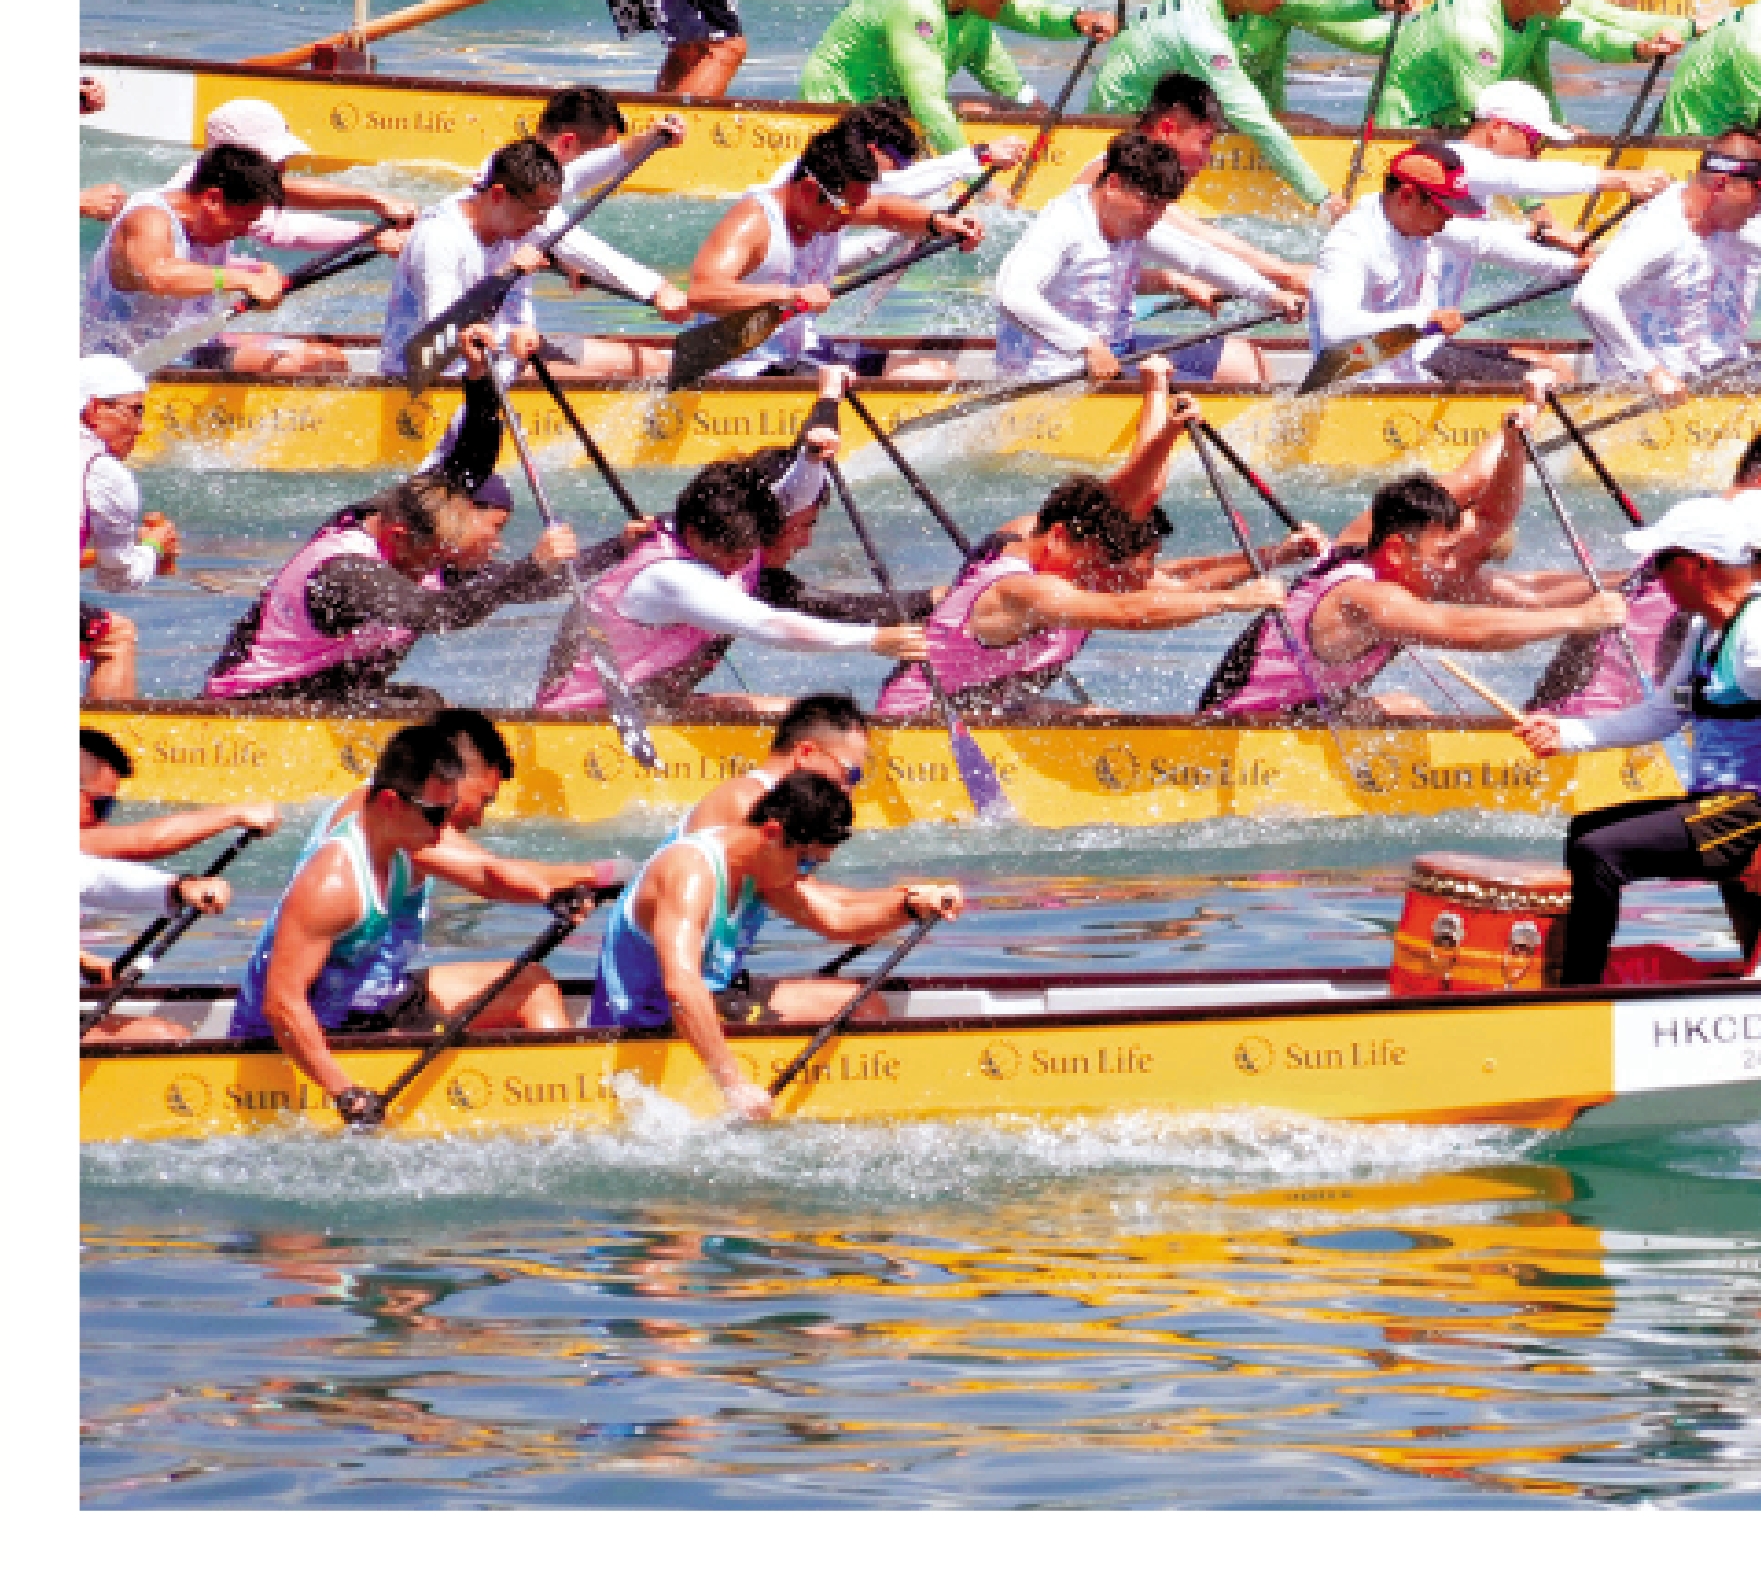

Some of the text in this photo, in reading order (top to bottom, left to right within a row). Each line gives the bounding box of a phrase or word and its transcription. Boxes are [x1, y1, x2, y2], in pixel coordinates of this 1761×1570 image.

[365, 111, 456, 134] Sun Life
[693, 410, 750, 435] Sun
[154, 740, 268, 768] Sun Life
[885, 758, 948, 782] Sun
[1217, 757, 1281, 787] Life
[1410, 760, 1544, 790] Sun Life
[842, 1050, 900, 1080] Life
[1030, 1046, 1155, 1075] Sun Life
[1286, 1039, 1408, 1069] Sun Life
[224, 1085, 293, 1110] Sun
[503, 1077, 570, 1104] Sun
